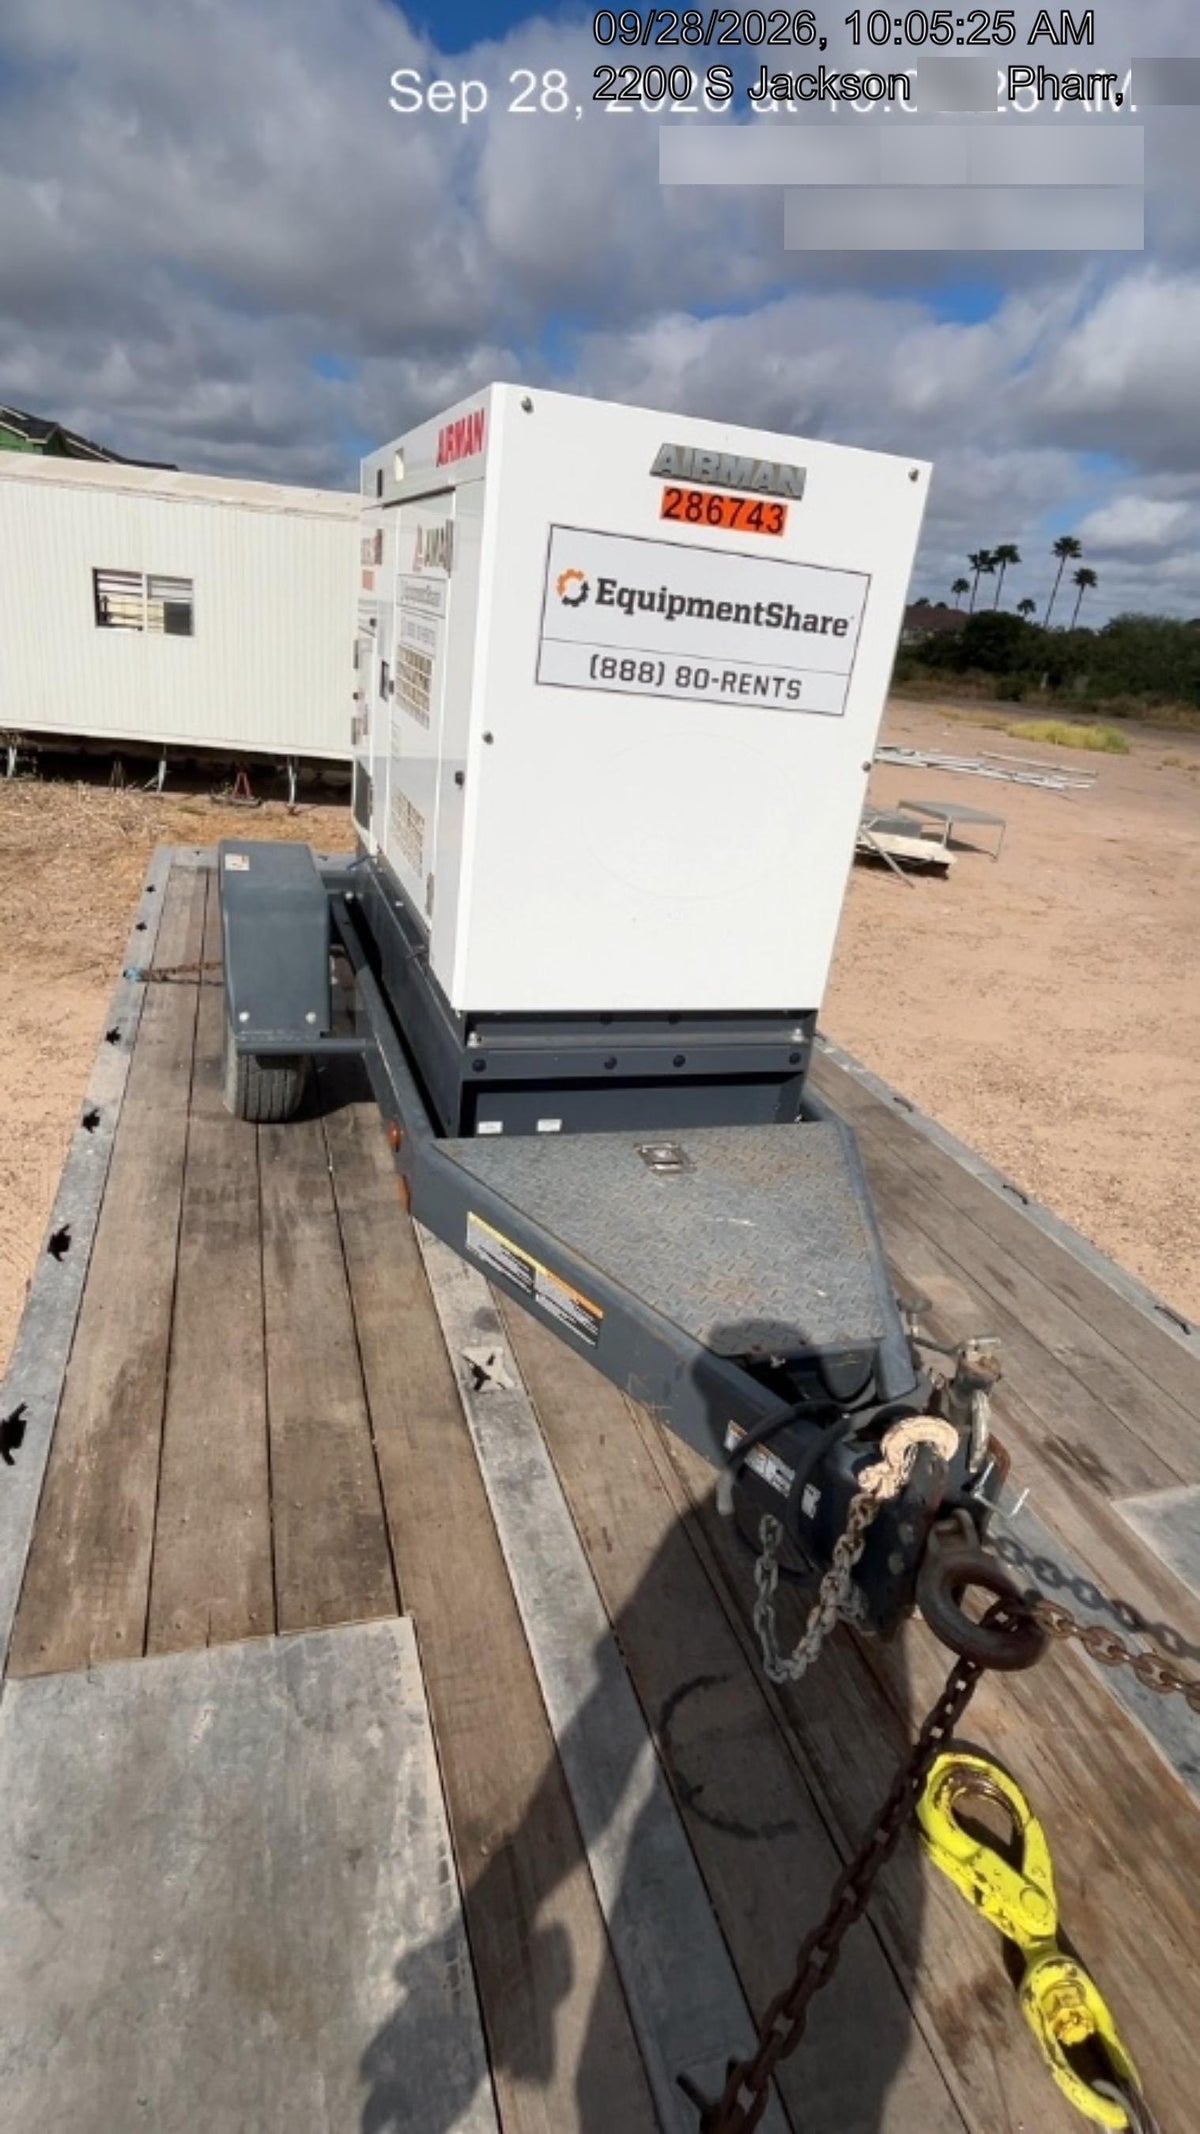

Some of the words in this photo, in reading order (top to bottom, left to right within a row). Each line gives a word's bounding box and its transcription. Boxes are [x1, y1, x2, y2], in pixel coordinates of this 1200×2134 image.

[650, 443, 807, 501] AIRMAN
[662, 487, 786, 535] 286743
[594, 577, 850, 638] EquipmentShare
[589, 653, 666, 688] (888)
[674, 665, 803, 701] 80-RENTS
